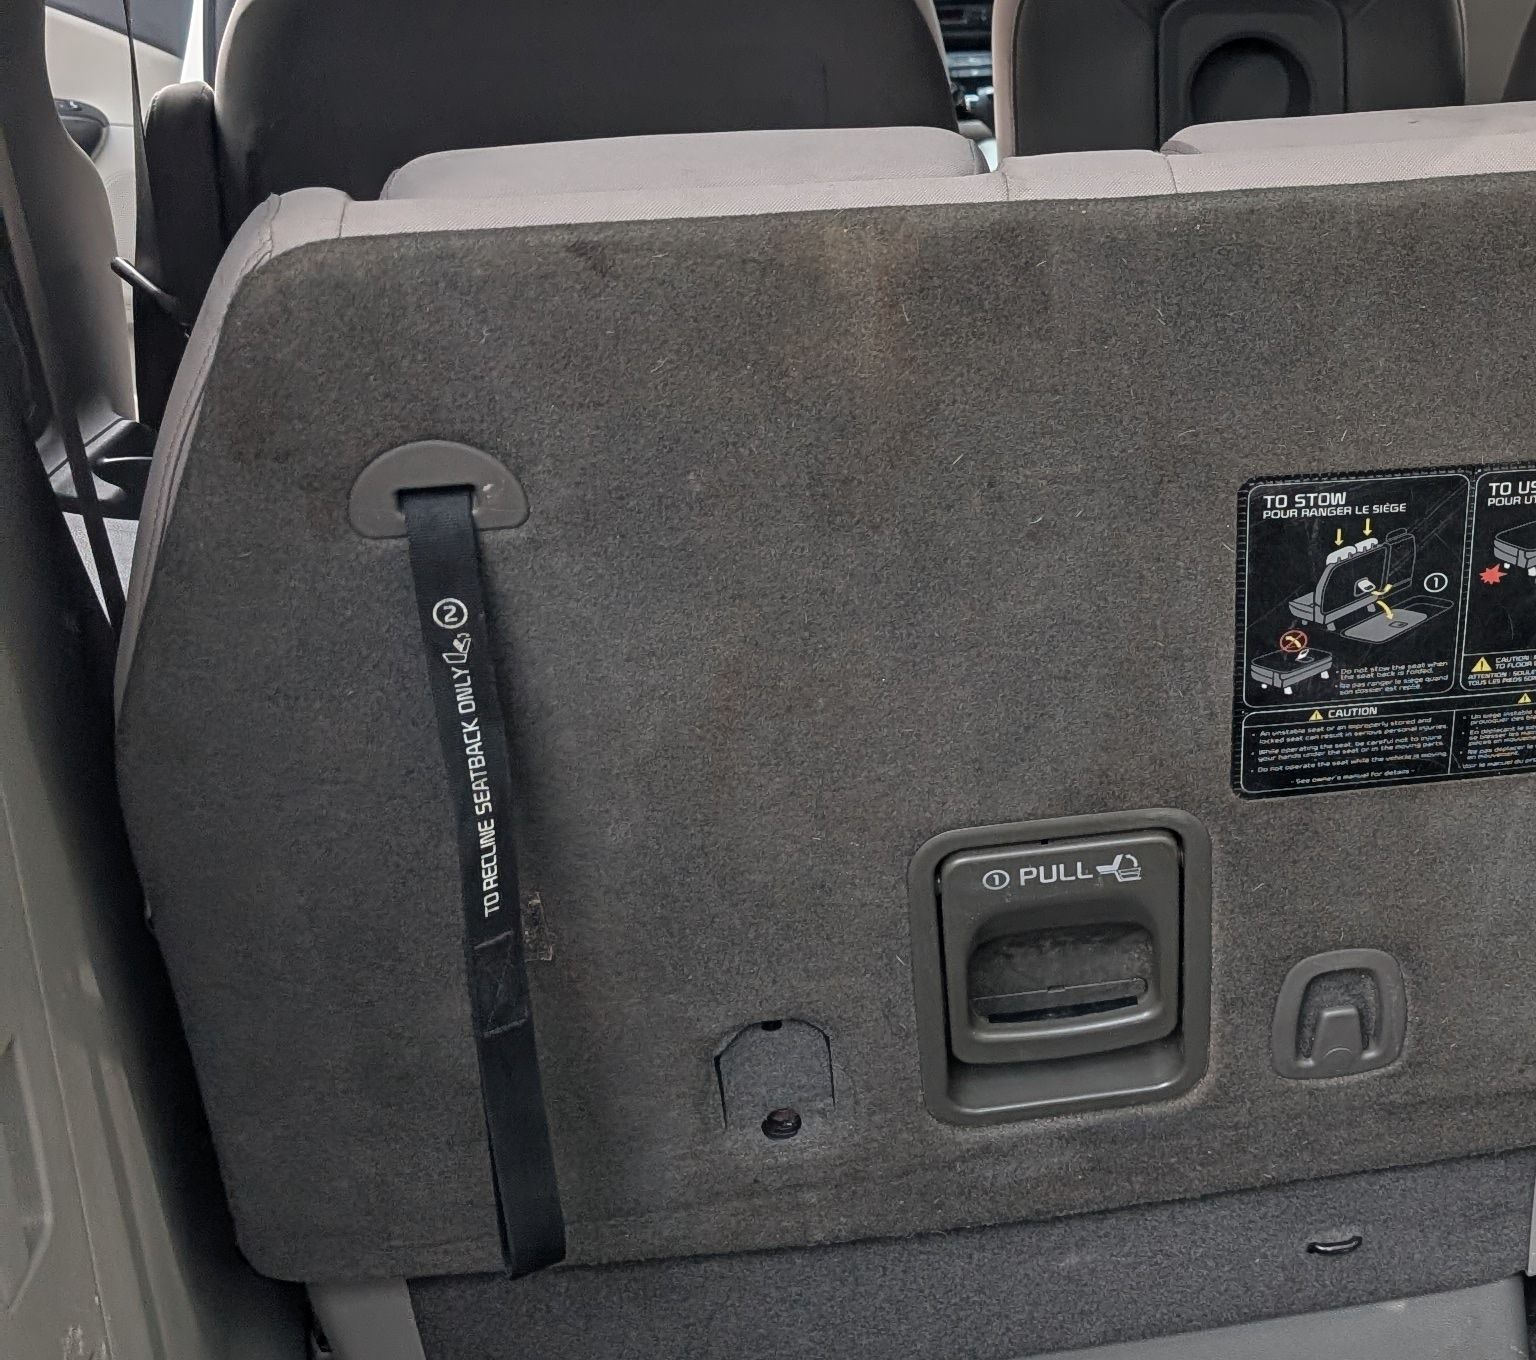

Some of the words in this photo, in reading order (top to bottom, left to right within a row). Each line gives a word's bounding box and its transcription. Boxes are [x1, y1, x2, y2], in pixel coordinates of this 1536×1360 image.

[1489, 482, 1511, 496] TO
[1263, 494, 1288, 508] TO
[1294, 492, 1346, 507] STOW
[1488, 496, 1521, 506] POUR
[1263, 508, 1298, 519] POUR
[1301, 506, 1352, 518] RANGER
[1355, 505, 1369, 514] LE
[452, 666, 476, 714] ONLY
[1328, 706, 1377, 718] CAUTION
[461, 717, 493, 815] SEATBACK
[478, 818, 499, 892] RECLINE
[1020, 862, 1093, 886] PULL
[484, 892, 500, 918] TO
